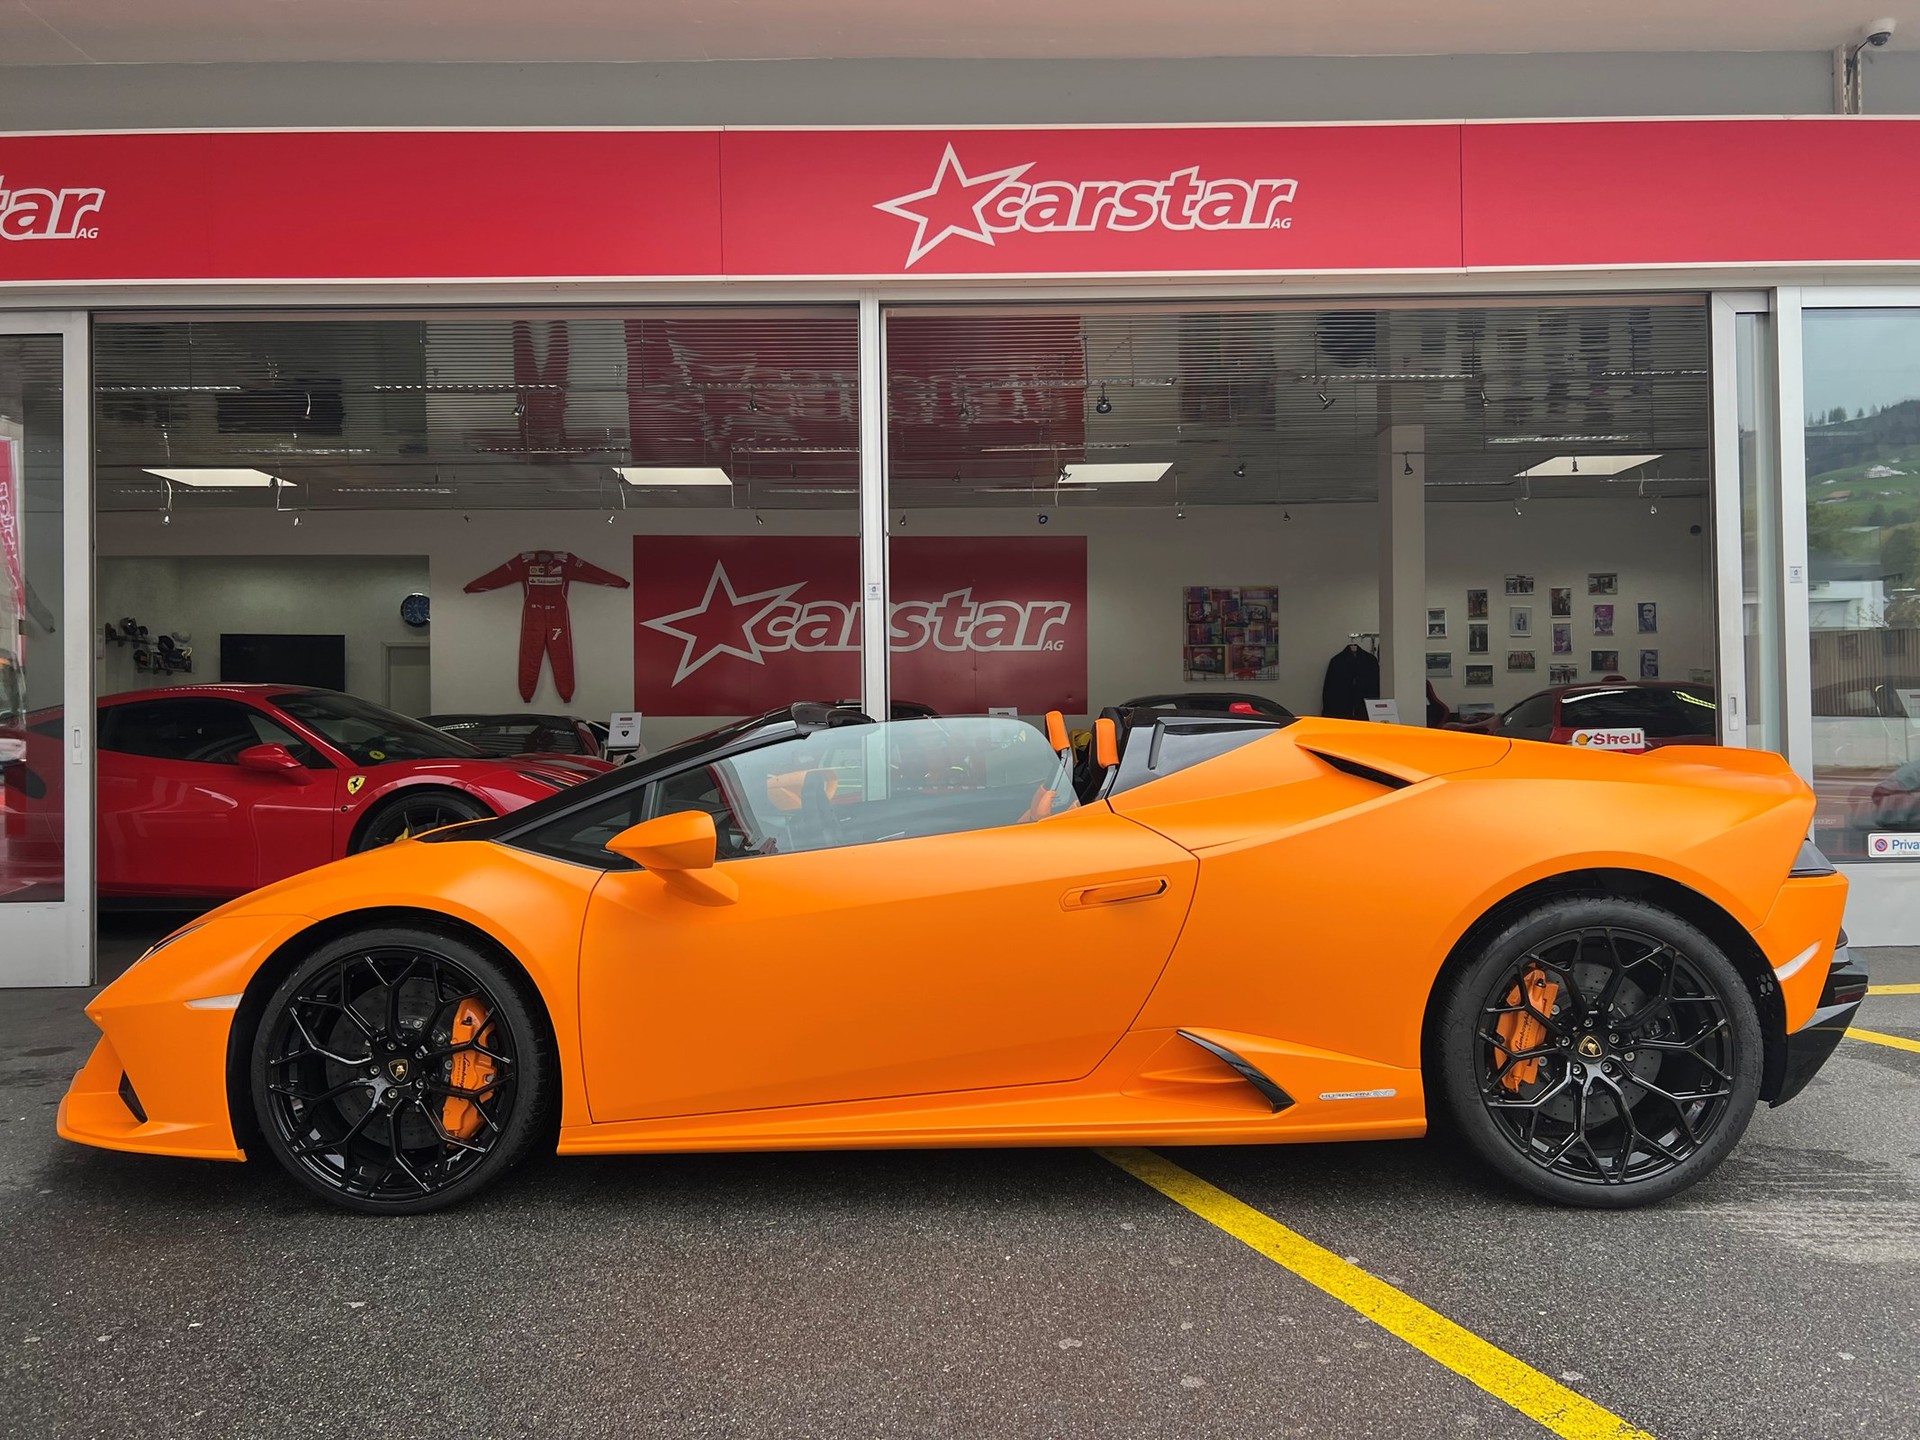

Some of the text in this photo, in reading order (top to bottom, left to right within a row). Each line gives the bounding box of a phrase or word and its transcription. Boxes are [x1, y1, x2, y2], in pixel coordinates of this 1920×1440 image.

[980, 165, 1298, 232] carstar AG
[0, 175, 106, 241] ar AG
[552, 628, 562, 640] 7
[1042, 640, 1064, 651] AG
[1593, 732, 1641, 745] Shell
[1892, 839, 1920, 850] Priva
